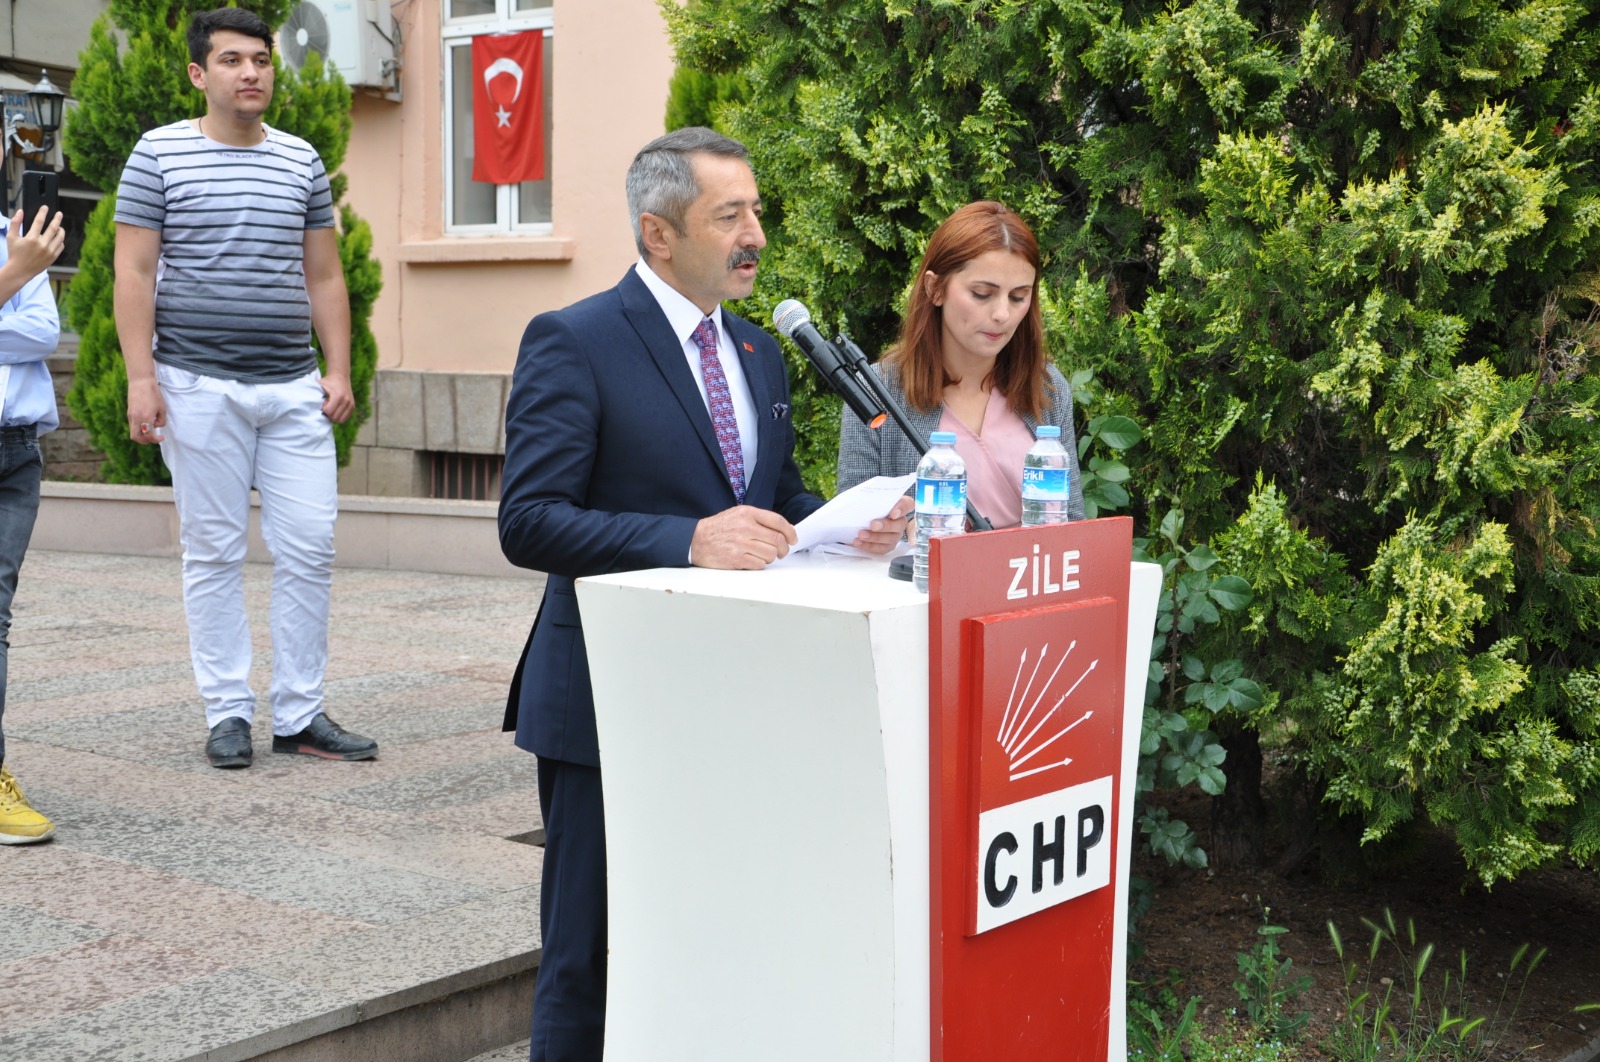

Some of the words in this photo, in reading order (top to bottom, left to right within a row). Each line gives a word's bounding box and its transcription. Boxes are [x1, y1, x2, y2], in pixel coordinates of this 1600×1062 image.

[1023, 469, 1044, 481] Erikli
[1007, 544, 1081, 600] ZİLE
[984, 804, 1105, 908] CHP
